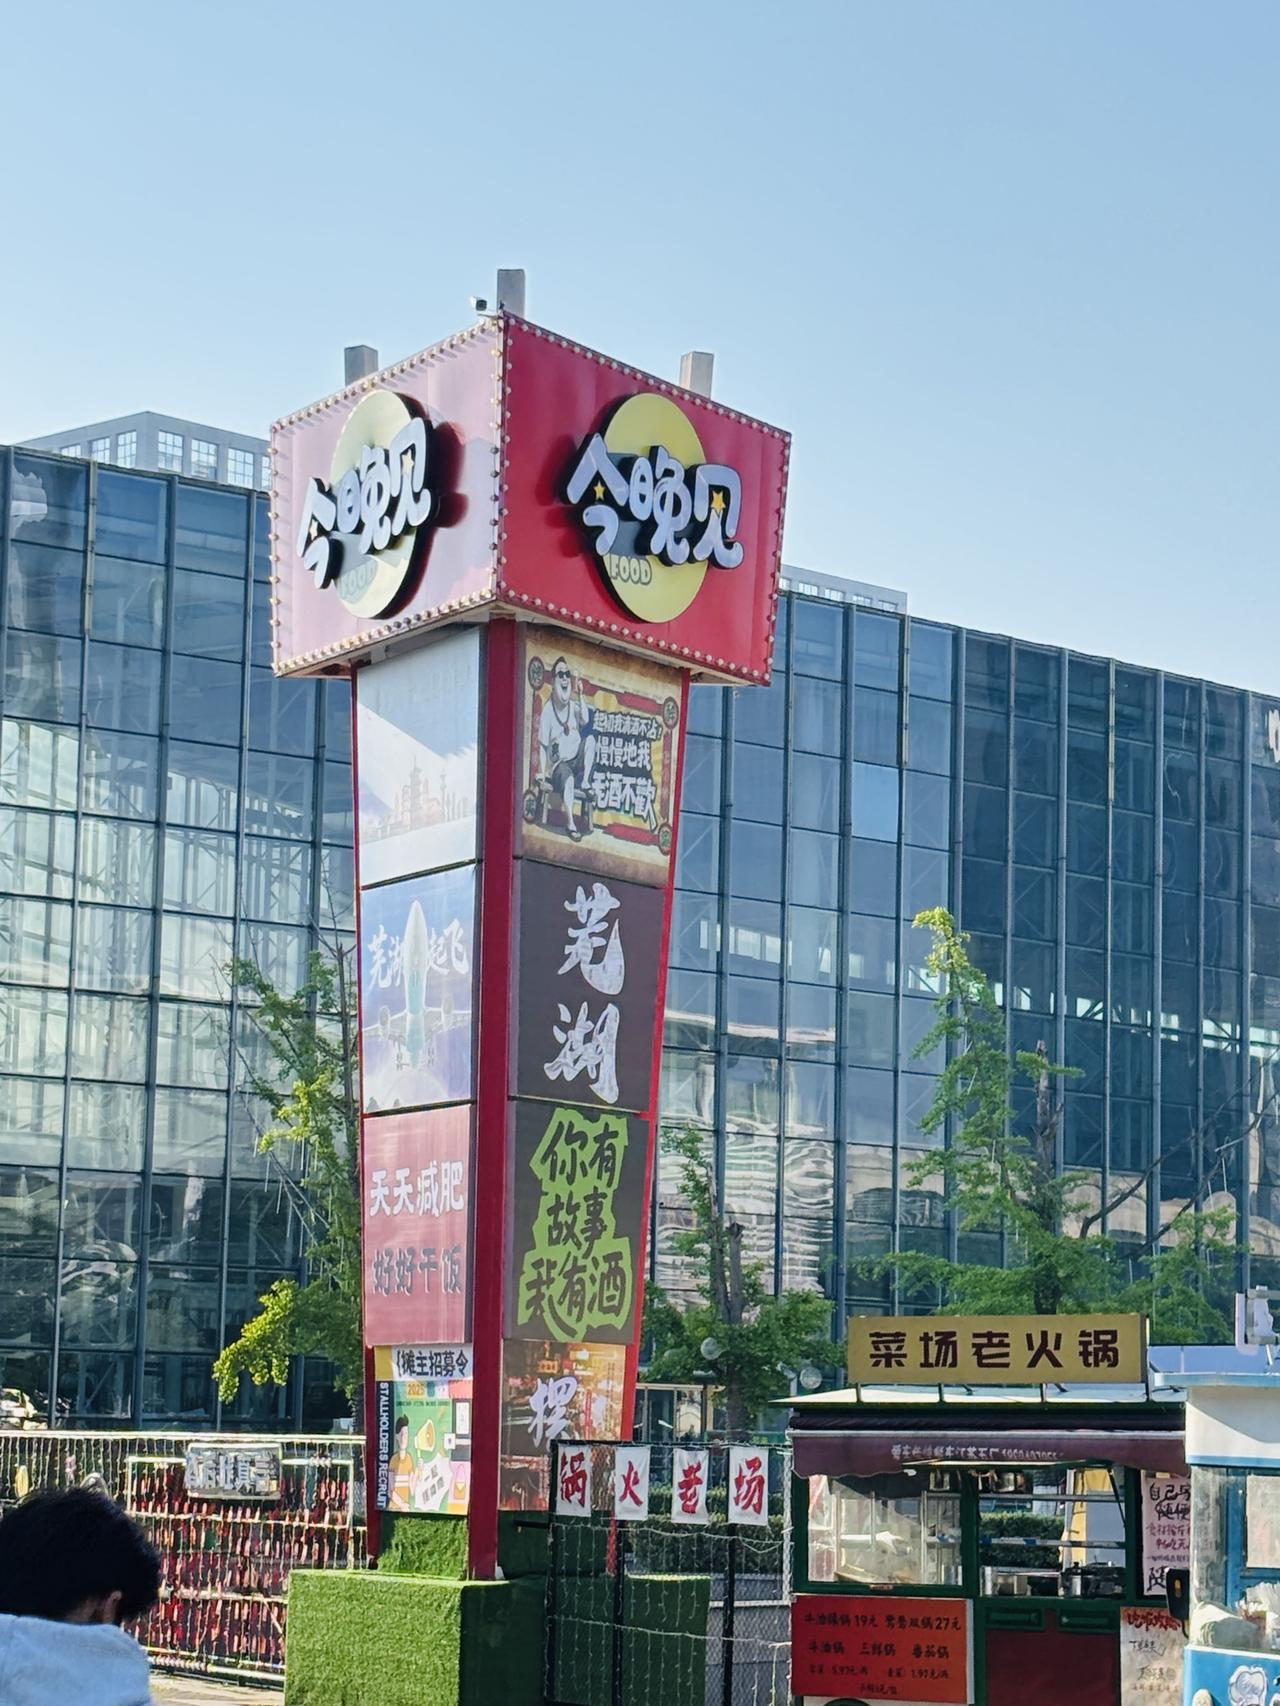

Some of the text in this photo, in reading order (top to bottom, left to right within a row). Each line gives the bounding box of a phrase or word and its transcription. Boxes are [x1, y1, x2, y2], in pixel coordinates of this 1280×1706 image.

[566, 433, 744, 568] 今晚见
[608, 556, 652, 586] FOOD
[596, 735, 651, 771] 慢慢地我
[544, 881, 625, 1104] 芜湖
[544, 1119, 621, 1187] 你有
[369, 1158, 465, 1217] 天天减肥
[546, 1191, 608, 1260] 故事
[372, 1245, 463, 1297] 好好干饭
[525, 1250, 627, 1338] 我有酒
[868, 1329, 1120, 1369] 菜场老火锅
[376, 1382, 389, 1509] STALLHOLDERS RECRUIT
[618, 1460, 644, 1507] 火
[733, 1455, 765, 1515] 场
